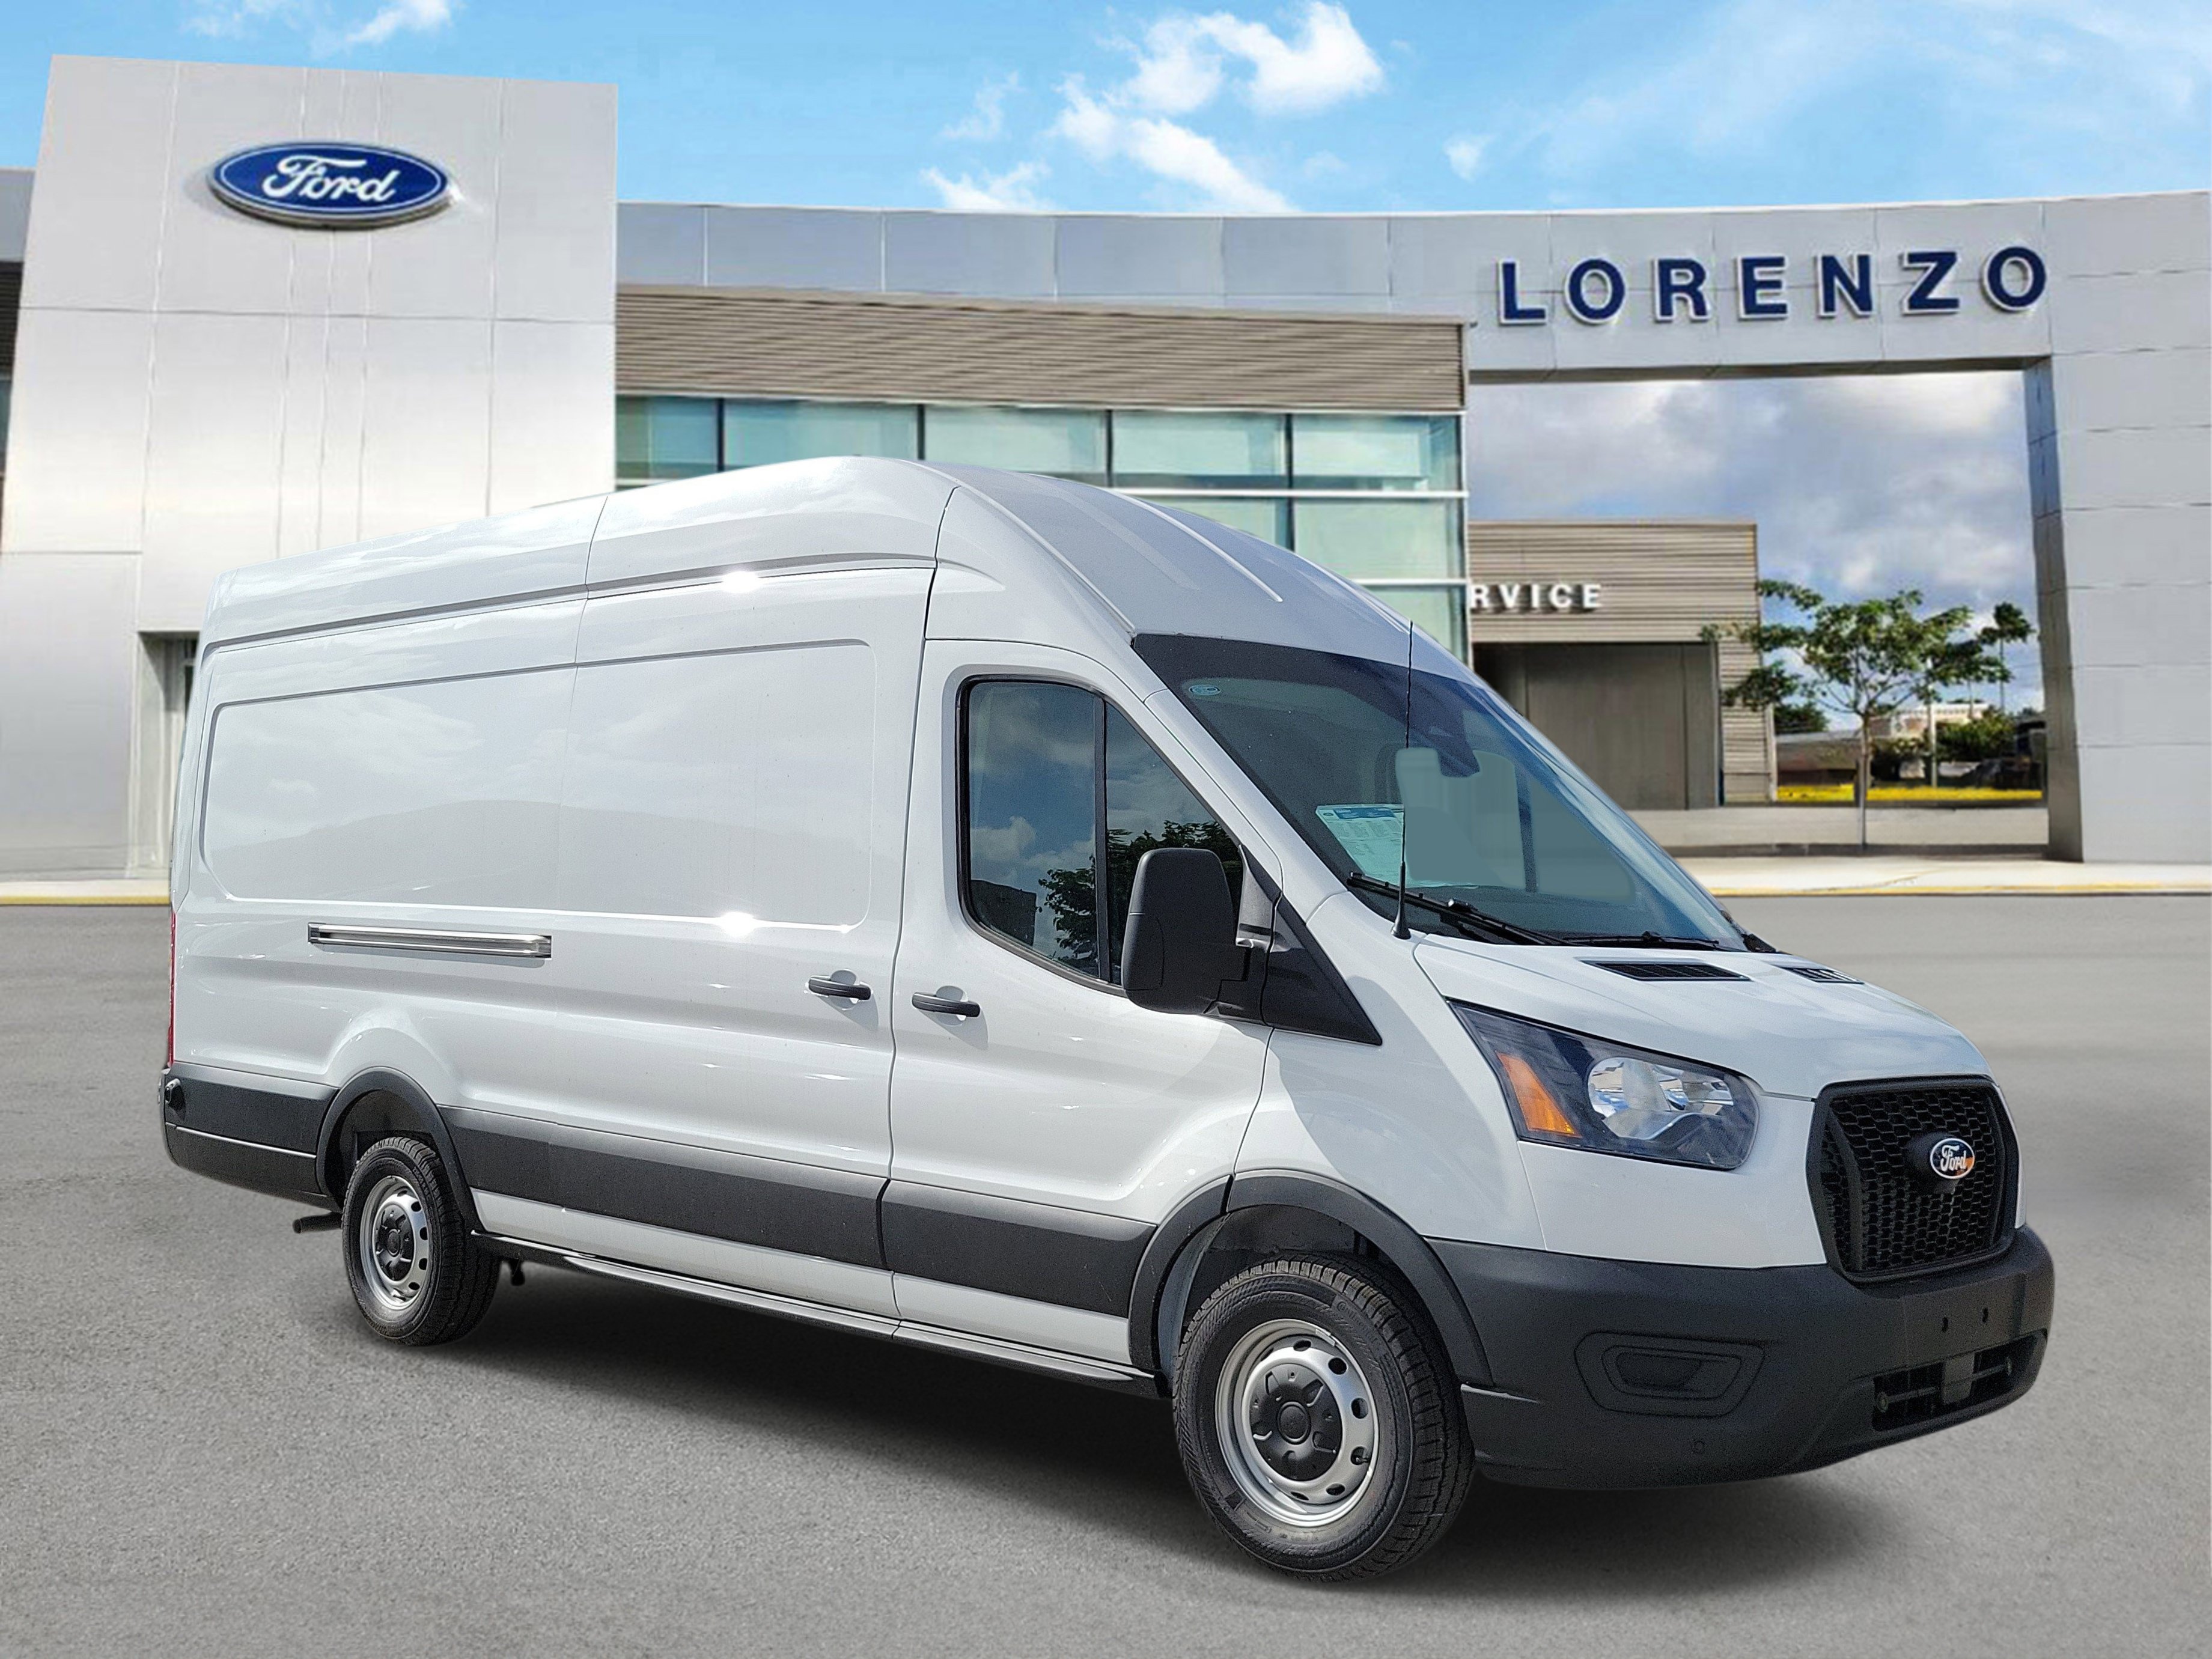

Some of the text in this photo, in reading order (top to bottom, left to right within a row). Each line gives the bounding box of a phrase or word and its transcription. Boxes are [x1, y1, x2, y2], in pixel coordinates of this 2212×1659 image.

[263, 154, 400, 202] Ford
[1499, 246, 2047, 325] LORENZO
[1470, 583, 1603, 609] RVICE
[1940, 1145, 1967, 1172] Ford
